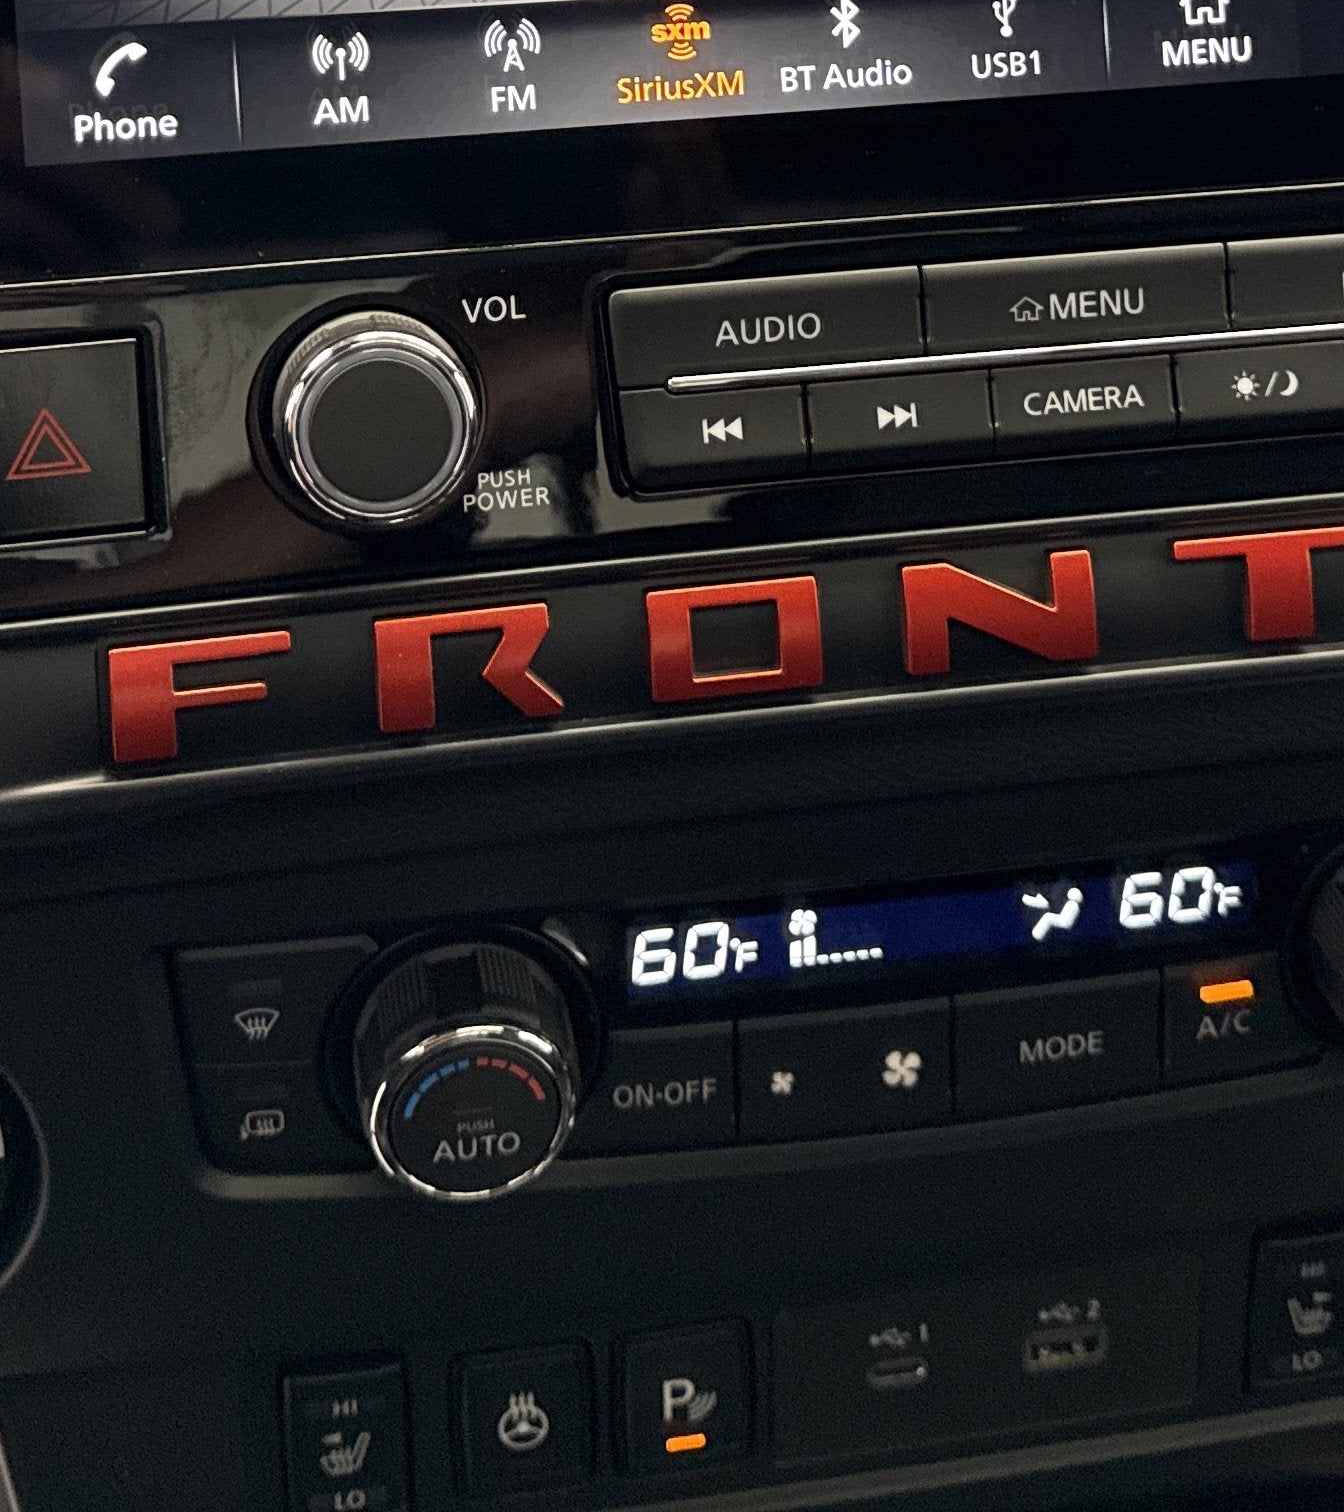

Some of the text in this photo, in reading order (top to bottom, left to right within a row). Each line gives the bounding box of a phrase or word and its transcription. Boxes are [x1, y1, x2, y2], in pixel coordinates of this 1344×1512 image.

[651, 20, 711, 44] sxm
[970, 50, 1042, 80] USB1
[1161, 35, 1253, 68] MENU
[617, 70, 745, 104] SiriusXM
[779, 59, 913, 92] BT Audio
[313, 94, 370, 125] AM
[490, 84, 537, 113] FM
[74, 111, 178, 143] Phone
[462, 295, 526, 324] VOL
[1048, 287, 1145, 321] MENU
[715, 312, 822, 348] AUDIO
[1023, 384, 1144, 418] CAMERA
[477, 468, 532, 490] PUSH
[463, 486, 550, 513] POWER
[1196, 1008, 1254, 1040] A/C
[1018, 1030, 1105, 1065] MODE
[432, 1130, 522, 1164] AUTO
